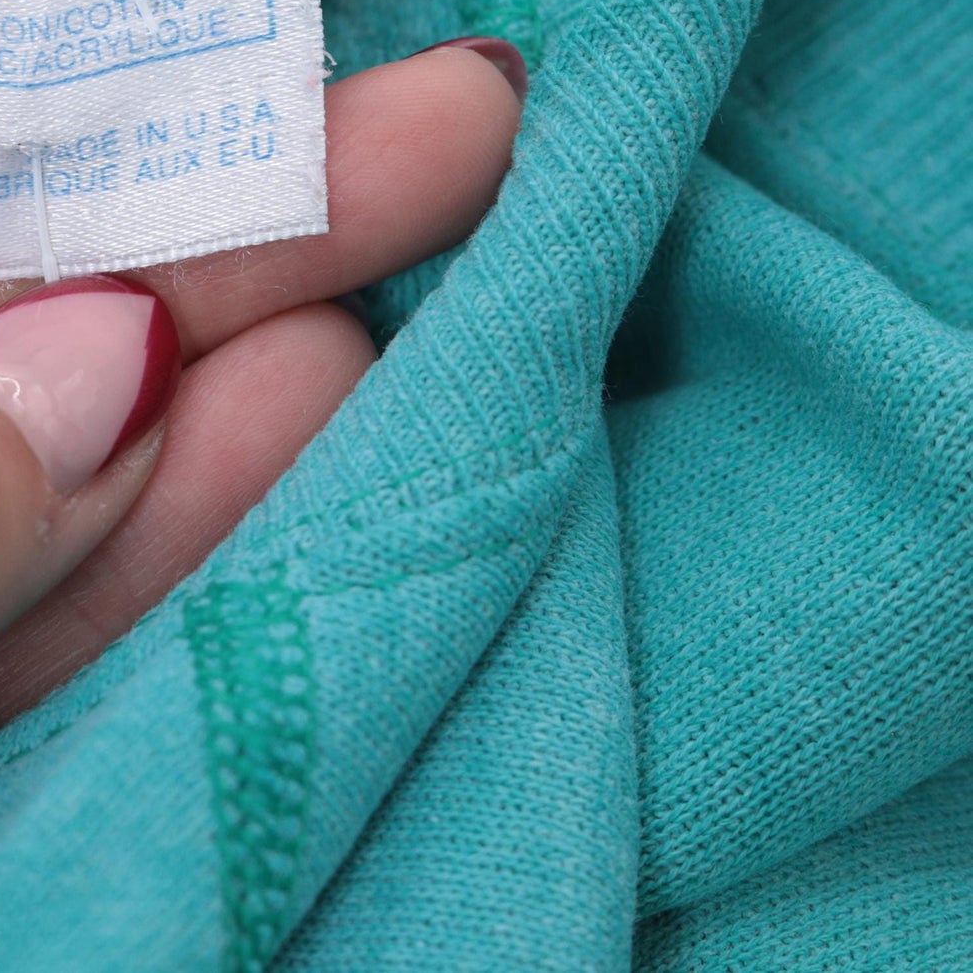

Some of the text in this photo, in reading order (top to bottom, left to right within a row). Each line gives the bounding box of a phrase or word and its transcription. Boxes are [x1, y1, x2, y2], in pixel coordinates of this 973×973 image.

[27, 128, 121, 164] ADE
[137, 120, 169, 150] IN
[135, 146, 202, 183] AUX
